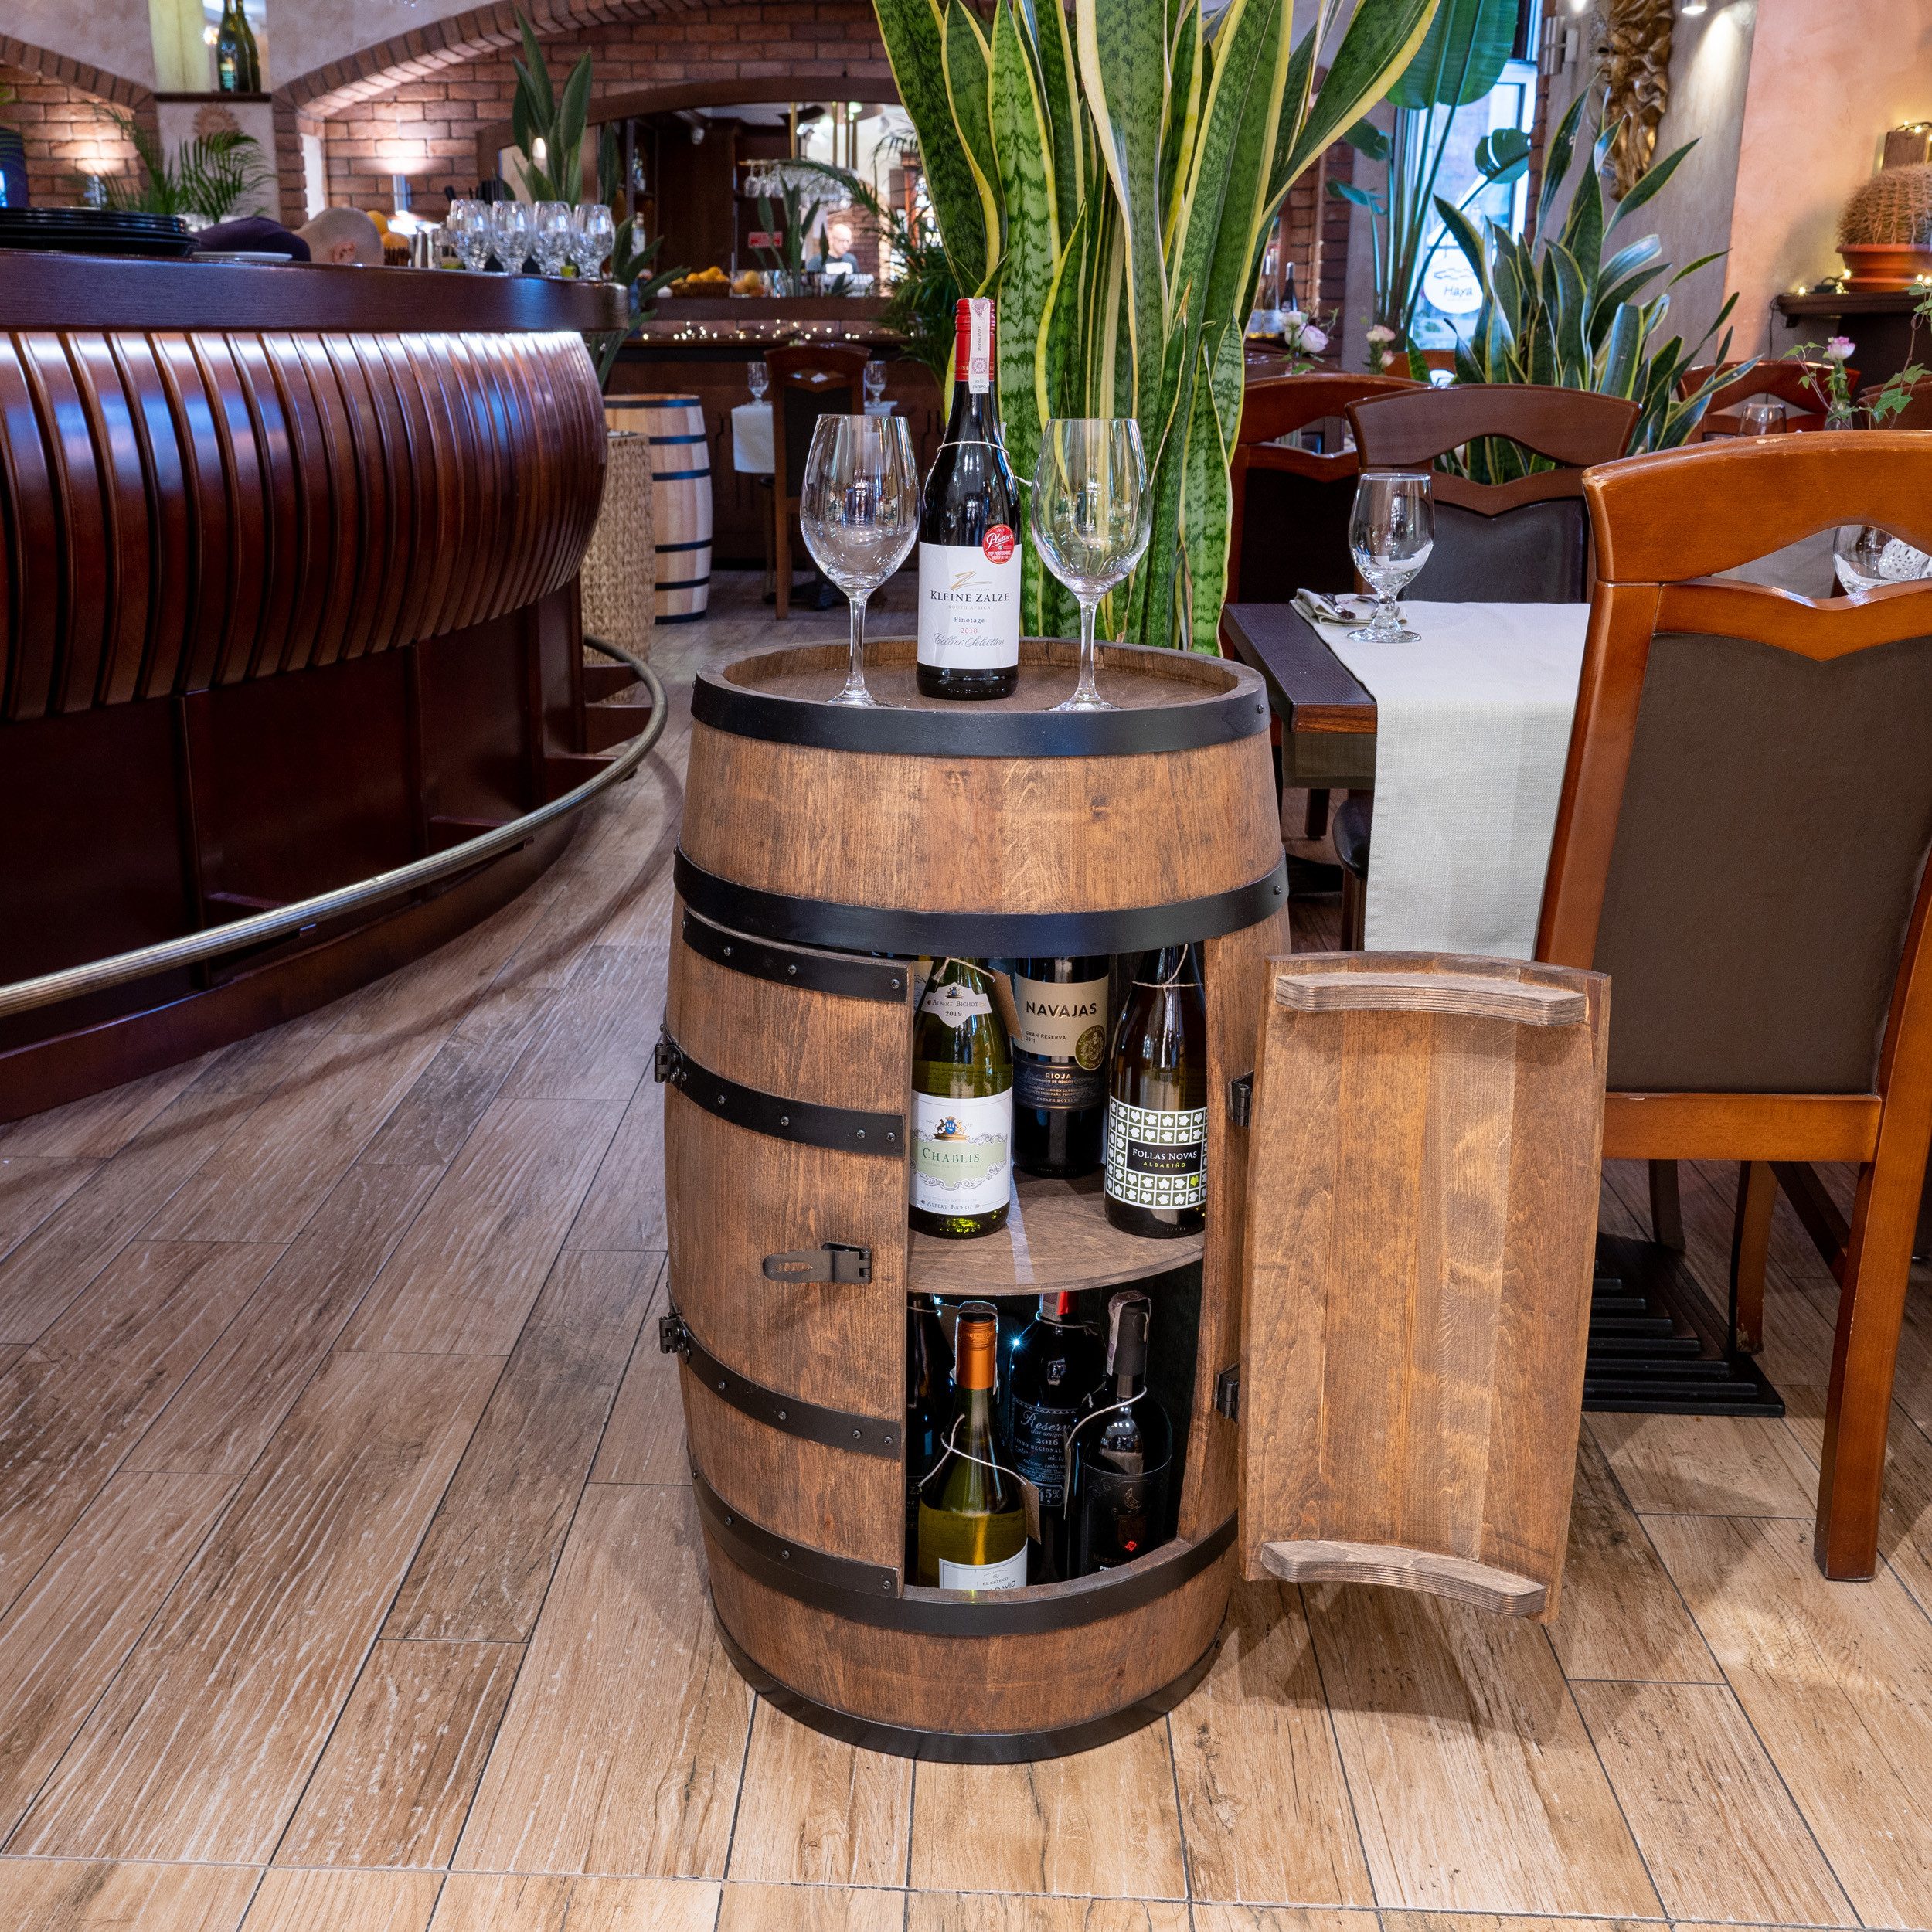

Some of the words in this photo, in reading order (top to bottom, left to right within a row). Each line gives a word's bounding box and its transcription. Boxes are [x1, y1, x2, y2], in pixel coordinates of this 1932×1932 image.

[1444, 286, 1473, 297] Haya
[930, 590, 972, 603] KLEINE
[975, 593, 1009, 603] ZALZE
[954, 616, 985, 624] Pinotage
[1026, 1001, 1097, 1018] NAVAJAS
[1026, 1030, 1039, 1039] GRAN
[1040, 1032, 1066, 1040] RESERVA
[922, 1148, 980, 1163] CHABLIS
[1133, 1148, 1165, 1160] FOLLAS
[1169, 1151, 1197, 1160] NOVAS
[1021, 1410, 1071, 1431] Reserv
[1036, 1437, 1059, 1446] 2016
